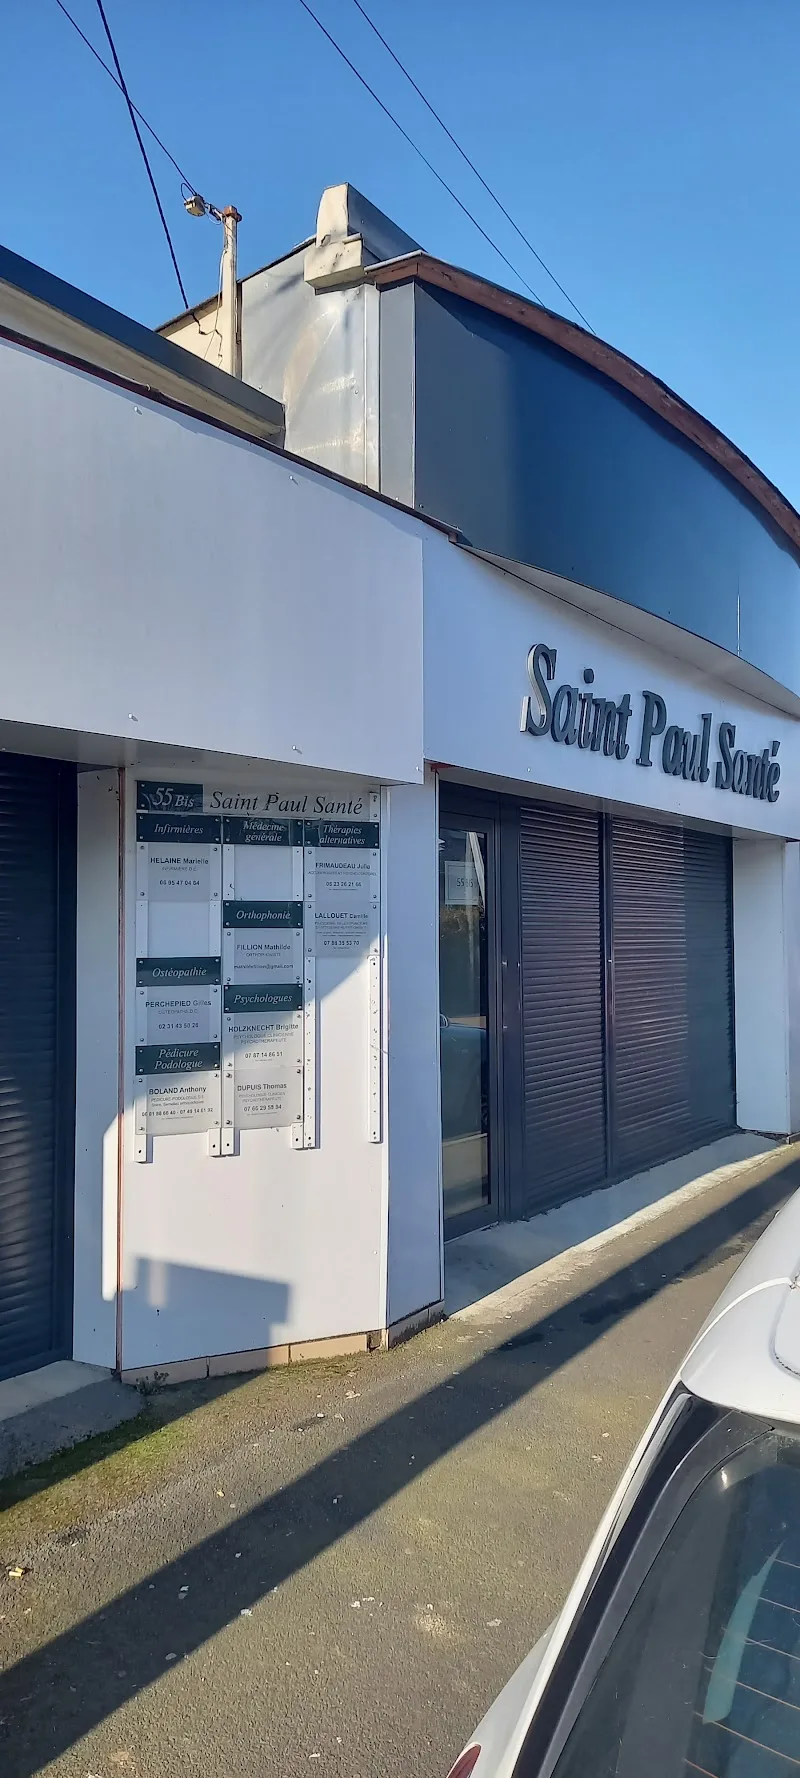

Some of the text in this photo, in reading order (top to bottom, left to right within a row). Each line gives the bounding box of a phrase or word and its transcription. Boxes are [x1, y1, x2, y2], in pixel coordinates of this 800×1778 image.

[520, 643, 781, 802] Saint Paul Santé
[152, 788, 194, 808] 55 Bis
[210, 790, 362, 814] Saint Paul Santé
[154, 823, 204, 835] Infirmières
[243, 820, 284, 832] Médecine
[322, 824, 362, 835] Thérapies
[245, 833, 282, 843] générale
[320, 834, 366, 846] alternatives
[236, 910, 291, 921] Orthophonie
[152, 967, 207, 978] Ostéopathie
[234, 994, 292, 1005] Psychologues
[228, 1024, 274, 1032] HOLZKNECHT
[158, 1048, 199, 1059] Pédicure
[155, 1059, 202, 1070] Podologue
